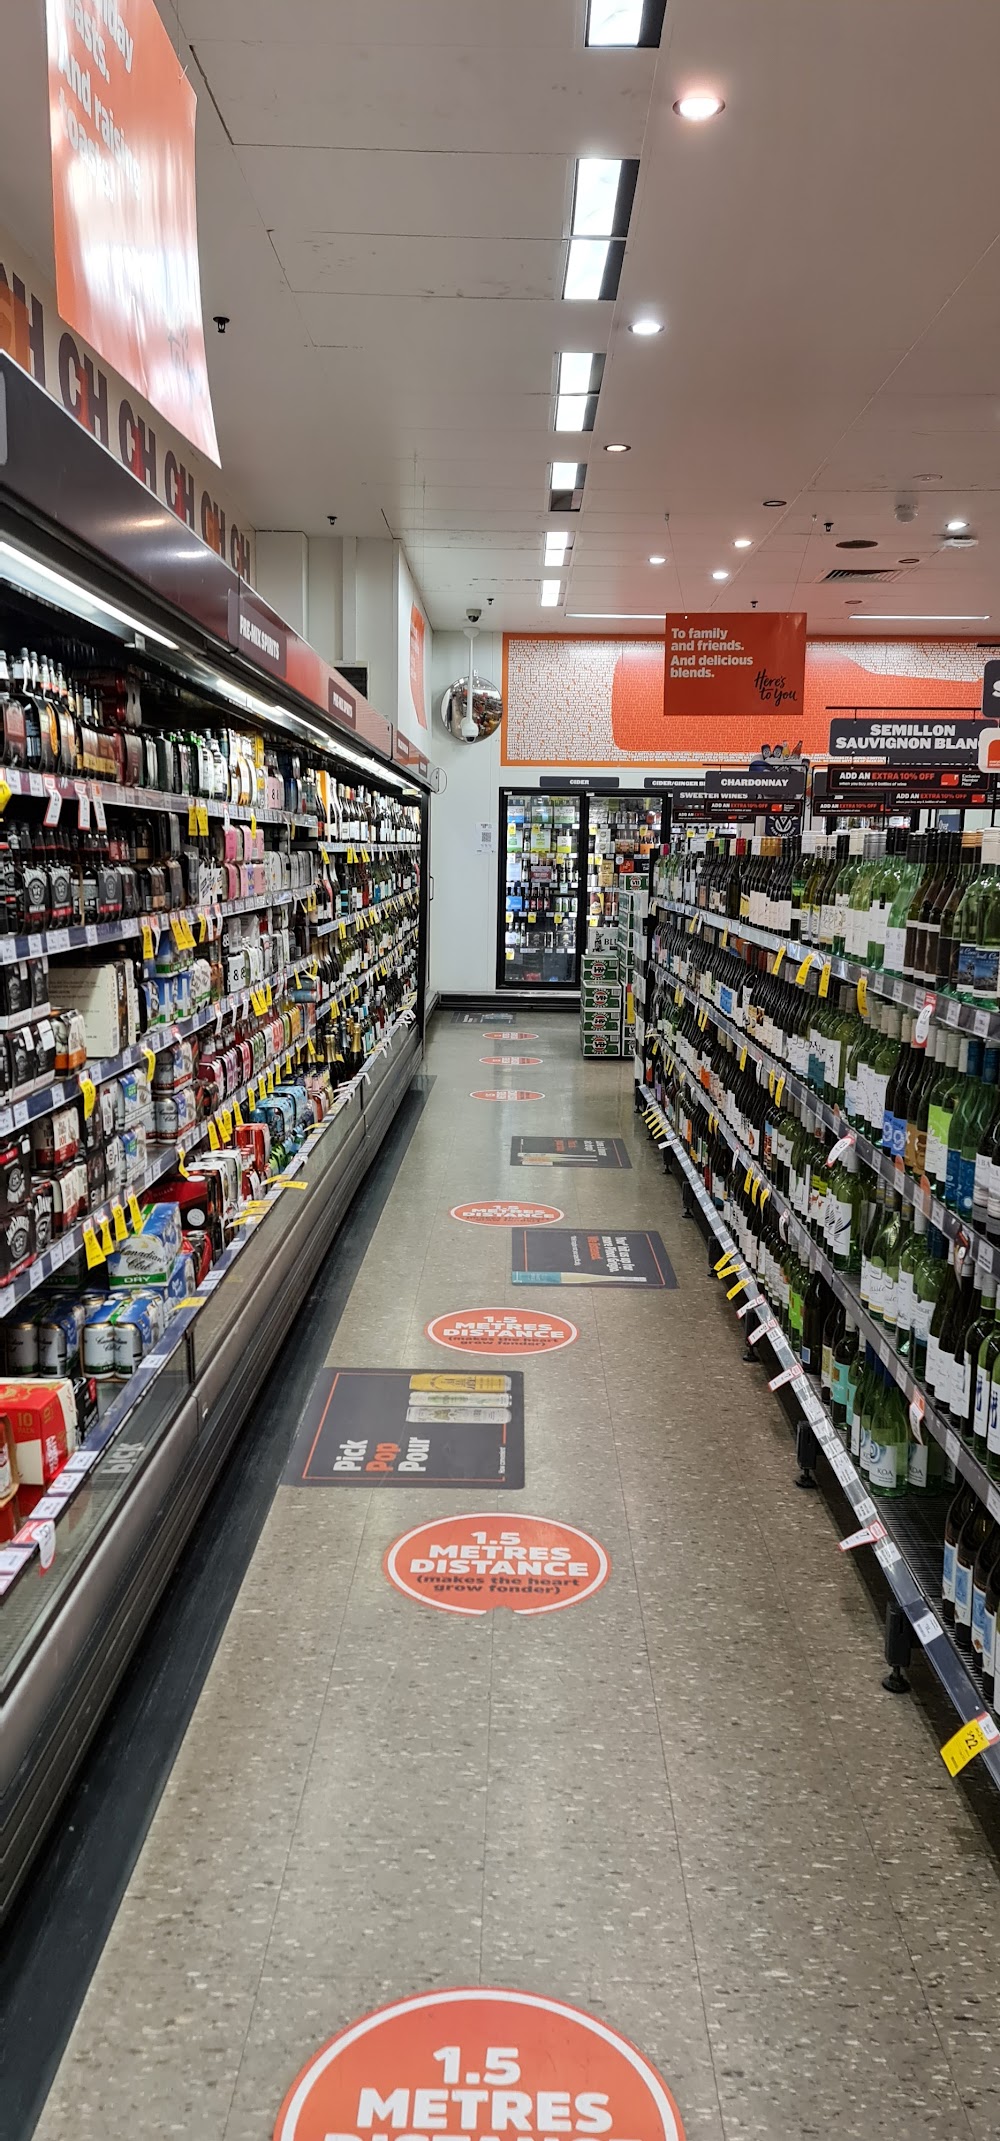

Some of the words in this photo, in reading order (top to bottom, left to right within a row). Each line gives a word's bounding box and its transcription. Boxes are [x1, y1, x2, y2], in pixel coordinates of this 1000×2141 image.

[239, 614, 262, 650] PRE-MIX
[261, 630, 280, 661] SPIRITS
[671, 628, 686, 639] To
[688, 628, 728, 640] family
[670, 640, 695, 651] and
[697, 640, 745, 651] friends.
[670, 655, 696, 666] And
[698, 655, 754, 666] delicious
[669, 667, 715, 678] blends.
[753, 669, 787, 690] Here's
[759, 686, 772, 701] to
[869, 724, 956, 737] SEMILLON
[835, 737, 931, 749] SAUVIGNON
[933, 738, 981, 750] BLAN
[720, 778, 789, 787] CHARDONNAY
[839, 772, 857, 780] ADD
[858, 772, 871, 780] AN
[601, 1236, 614, 1246] more
[119, 1244, 163, 1264] Canadian
[604, 1247, 618, 1258] Pinot
[126, 1254, 151, 1272] Club
[124, 1276, 150, 1284] DRY
[483, 1315, 518, 1323] 1.5
[455, 1322, 553, 1331] METRES
[443, 1329, 565, 1339] DISTANCE
[17, 1412, 33, 1427] 10
[332, 1439, 368, 1472] Pick
[365, 1442, 401, 1472] Pop
[398, 1436, 431, 1472] Pour
[877, 1467, 894, 1478] KOA
[470, 1531, 521, 1546] 1.5
[428, 1544, 572, 1561] METRES
[409, 1559, 590, 1577] DISTANCE
[416, 1574, 485, 1585] (makes
[491, 1576, 522, 1586] the
[528, 1577, 580, 1587] heart
[434, 1583, 483, 1594] grow
[489, 1584, 561, 1595] fonder)
[432, 2045, 521, 2086] 1.5
[356, 2087, 613, 2133] METRES
